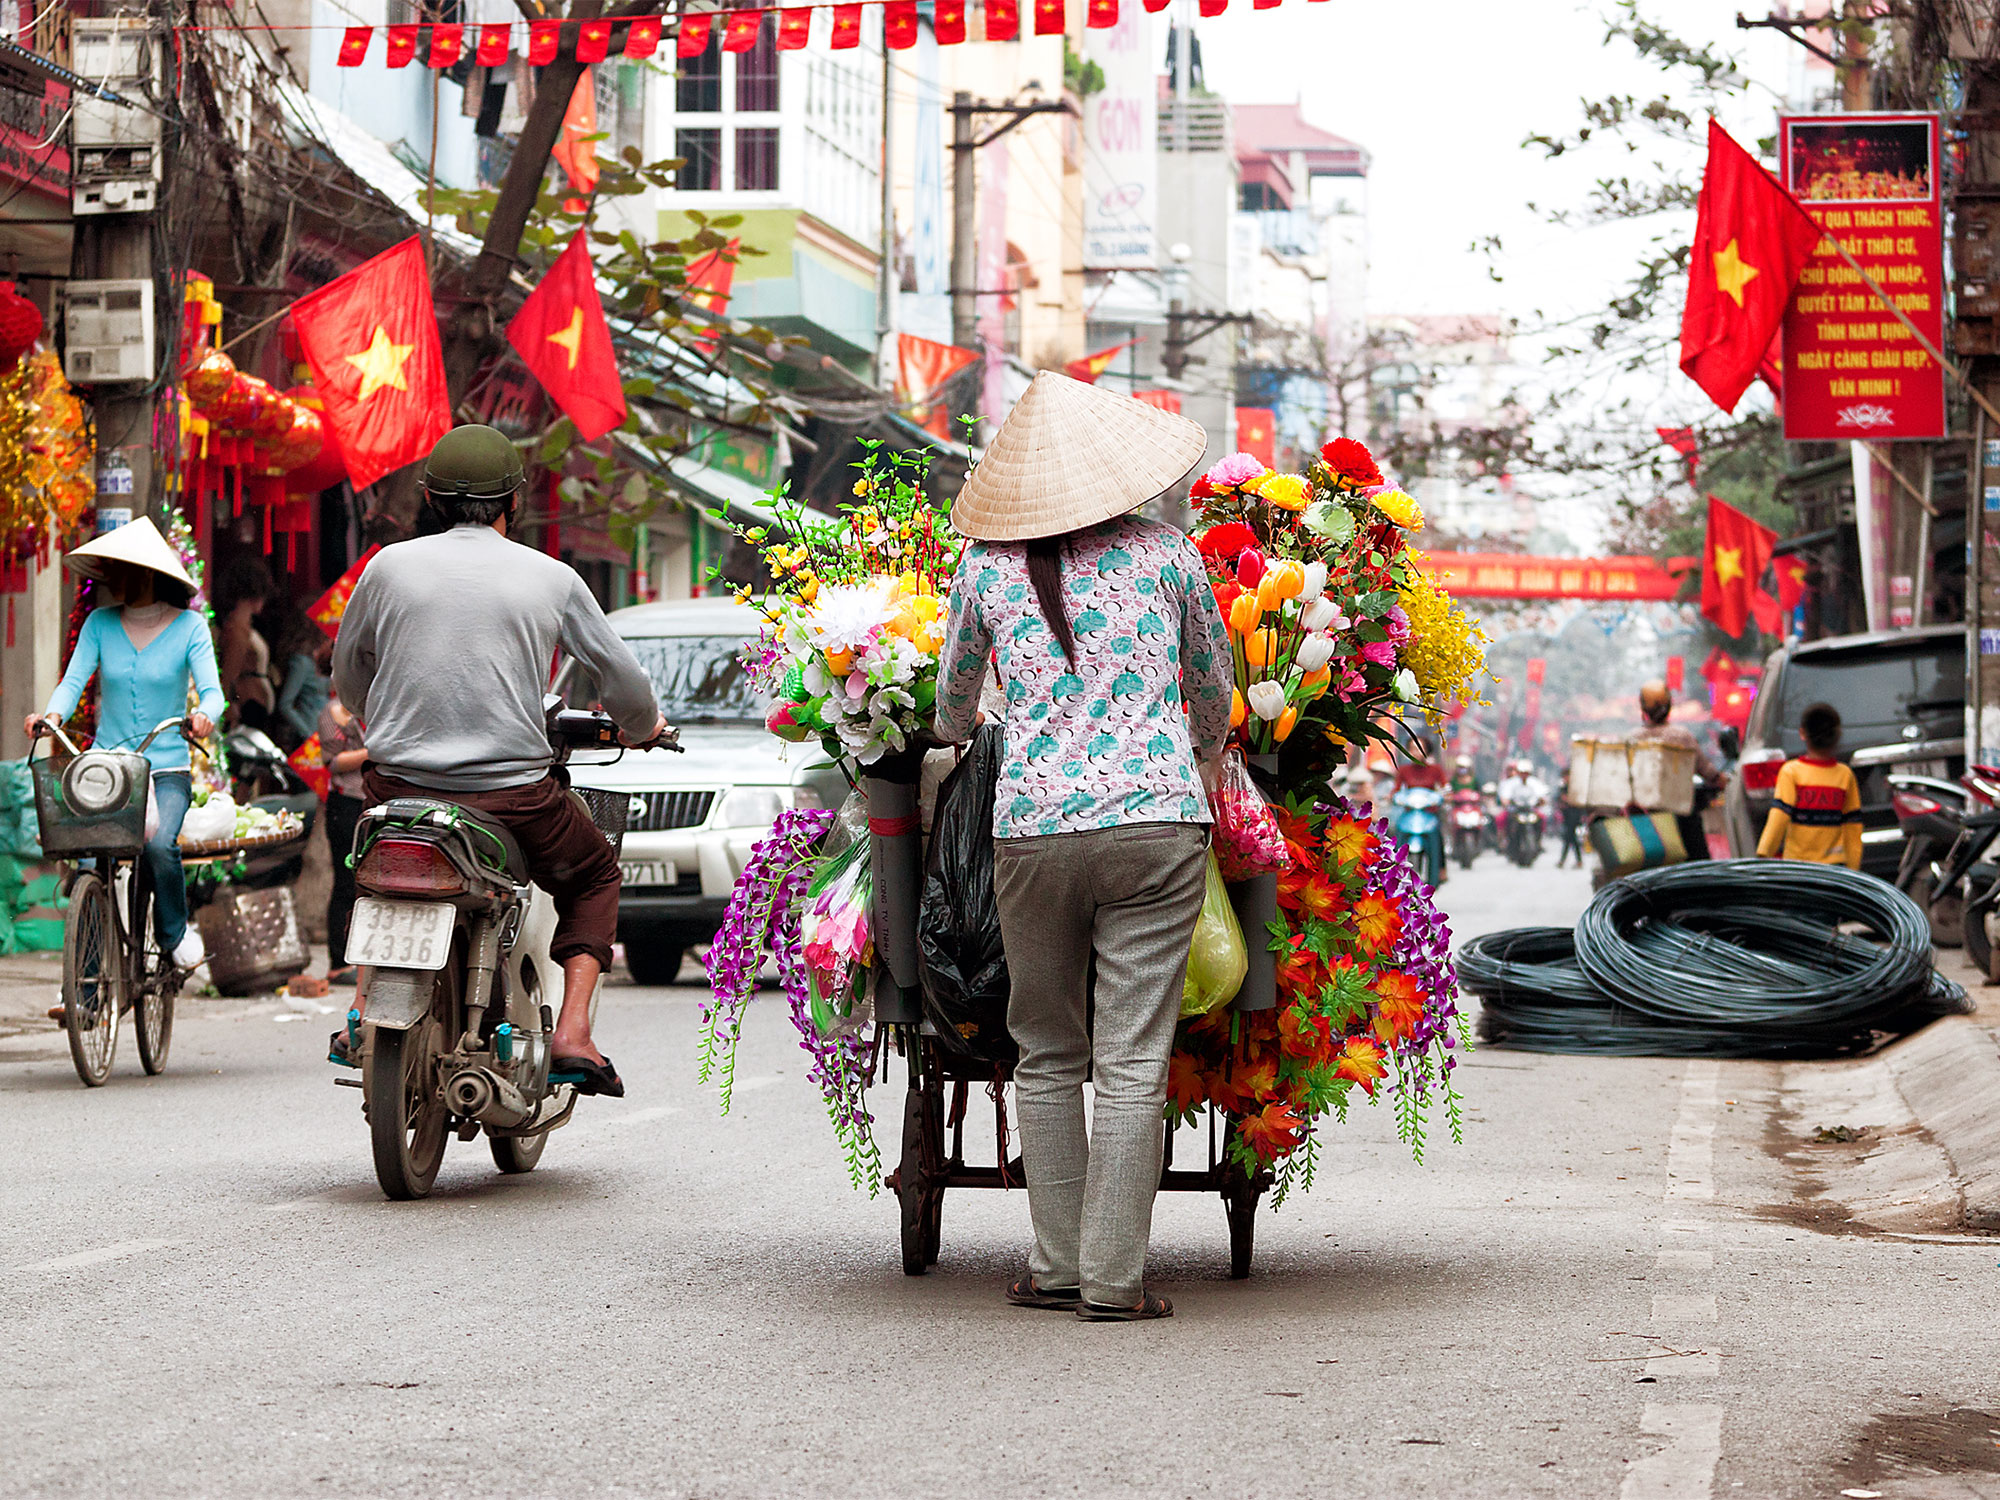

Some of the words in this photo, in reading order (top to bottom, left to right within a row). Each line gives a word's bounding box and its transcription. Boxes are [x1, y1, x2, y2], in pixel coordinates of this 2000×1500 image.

[1825, 211, 1851, 229] QUA
[1849, 323, 1878, 340] NAM
[1798, 349, 1831, 369] NGÀY
[1834, 348, 1869, 369] CÀNG
[1871, 348, 1900, 368] GIÀU
[1858, 379, 1892, 397] MINH
[393, 800, 448, 811] HONDA
[367, 903, 440, 933] 33-P9
[361, 933, 434, 964] 4336
